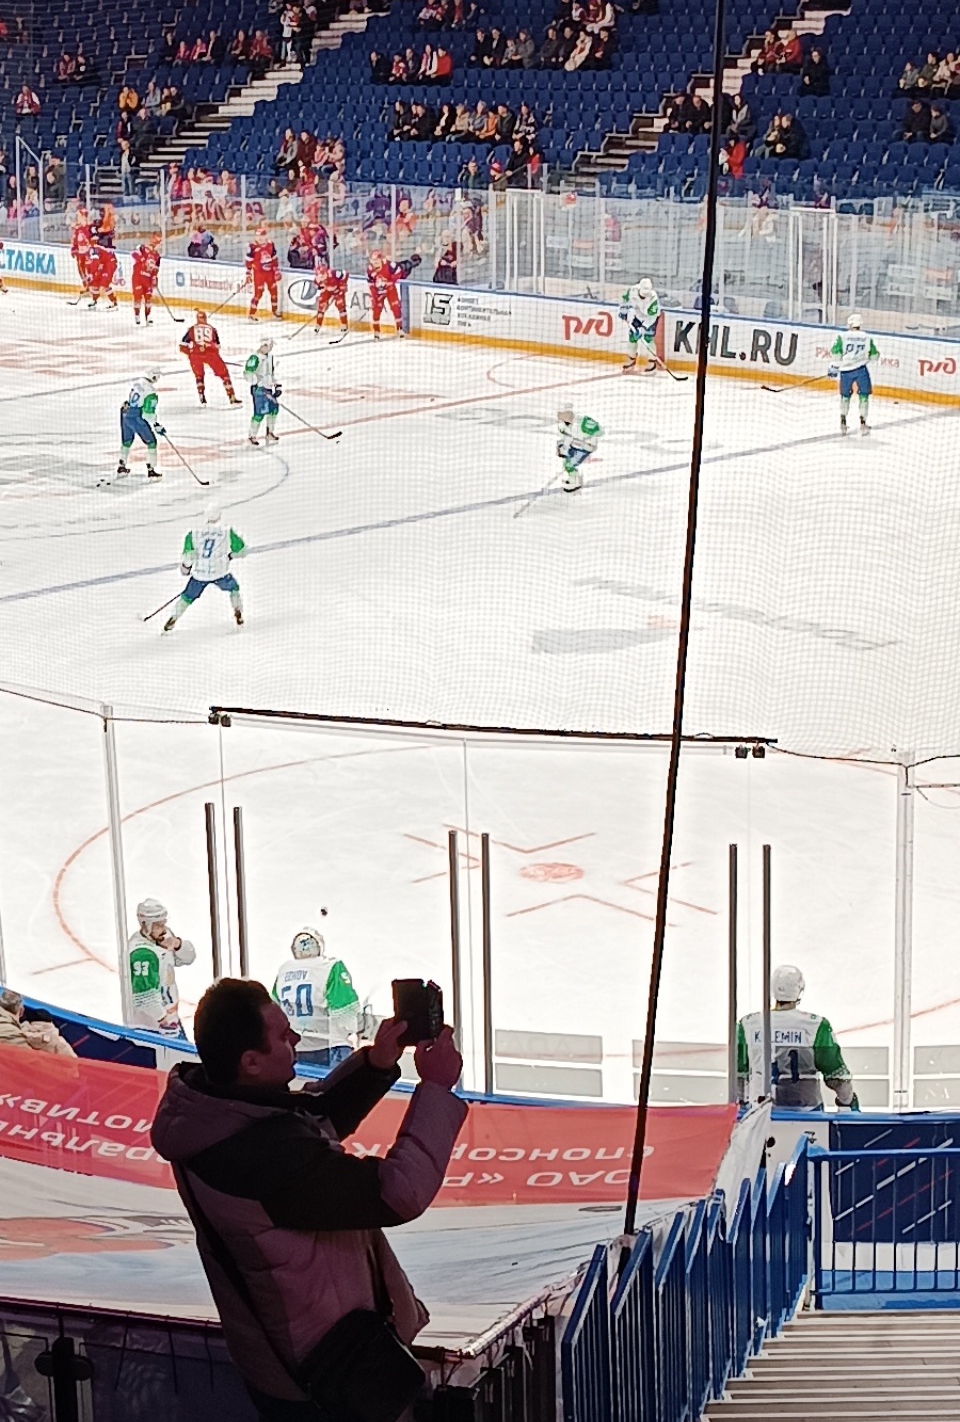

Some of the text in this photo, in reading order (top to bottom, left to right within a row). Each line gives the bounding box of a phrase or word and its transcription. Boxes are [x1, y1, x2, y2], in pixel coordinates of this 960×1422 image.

[674, 319, 799, 366] KHL.RU
[202, 538, 216, 559] 9
[754, 1030, 803, 1044] KEMIN
[527, 1169, 632, 1187] ОАО
